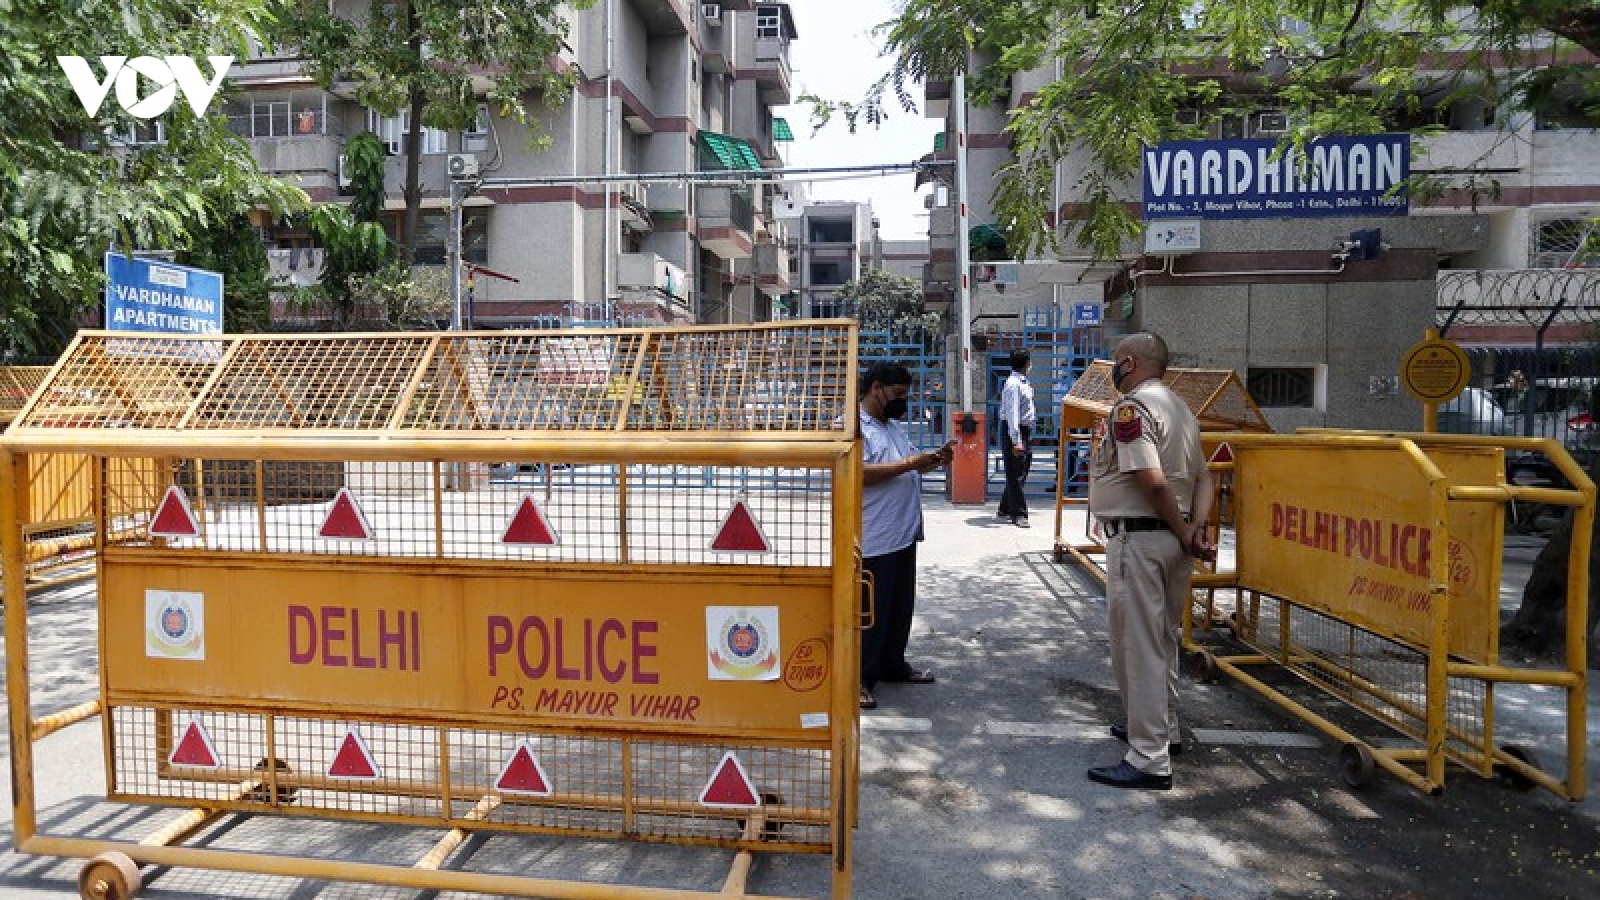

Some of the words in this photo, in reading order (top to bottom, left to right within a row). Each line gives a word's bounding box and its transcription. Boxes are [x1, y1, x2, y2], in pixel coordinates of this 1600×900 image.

[1146, 143, 1402, 197] VARDHAMAN
[113, 307, 217, 335] APARTMENTS
[117, 285, 215, 315] VARDHAMAN
[1271, 501, 1338, 553] DELHI
[1344, 516, 1431, 579] POLICE
[288, 605, 420, 672] DELHI
[487, 615, 659, 685] POLICE
[491, 685, 525, 711] PS.
[534, 687, 619, 717] MAYUR
[629, 693, 701, 722] VIHAR
